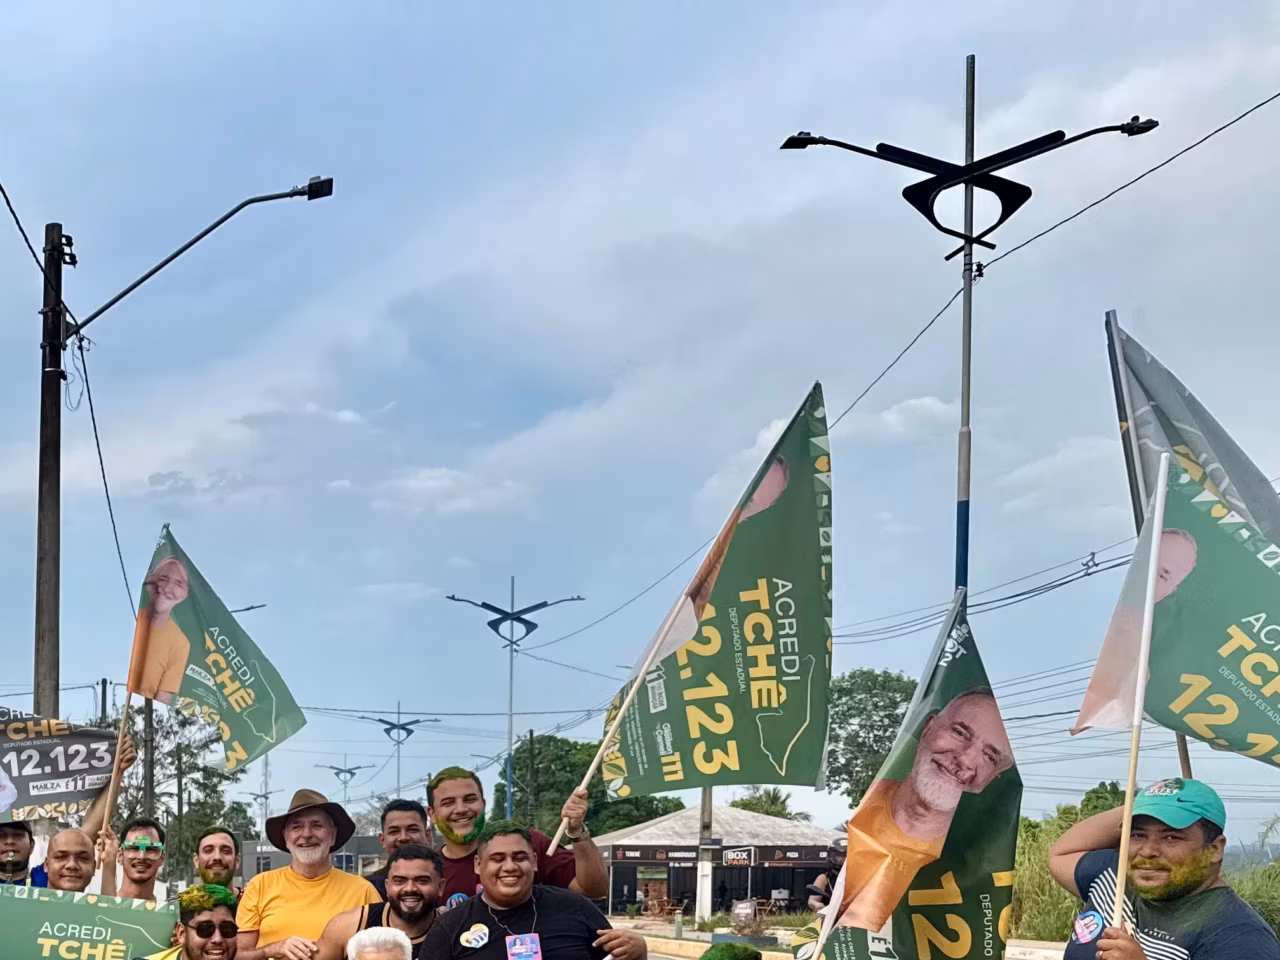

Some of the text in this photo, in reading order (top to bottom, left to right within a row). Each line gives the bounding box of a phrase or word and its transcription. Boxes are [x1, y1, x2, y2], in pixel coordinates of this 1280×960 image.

[729, 607, 746, 694] DEPUTADO ESTADUAL
[739, 578, 787, 708] TCHÊ
[773, 578, 800, 680] ACREDI
[209, 626, 255, 686] ACREDI
[1219, 666, 1257, 701] DEPUTADO
[2, 741, 112, 777] 12.123
[32, 782, 60, 791] MAILZA
[70, 775, 88, 791] 11
[728, 851, 748, 859] BOX
[39, 921, 112, 940] ACREDI
[980, 894, 993, 956] DEPUTADO
